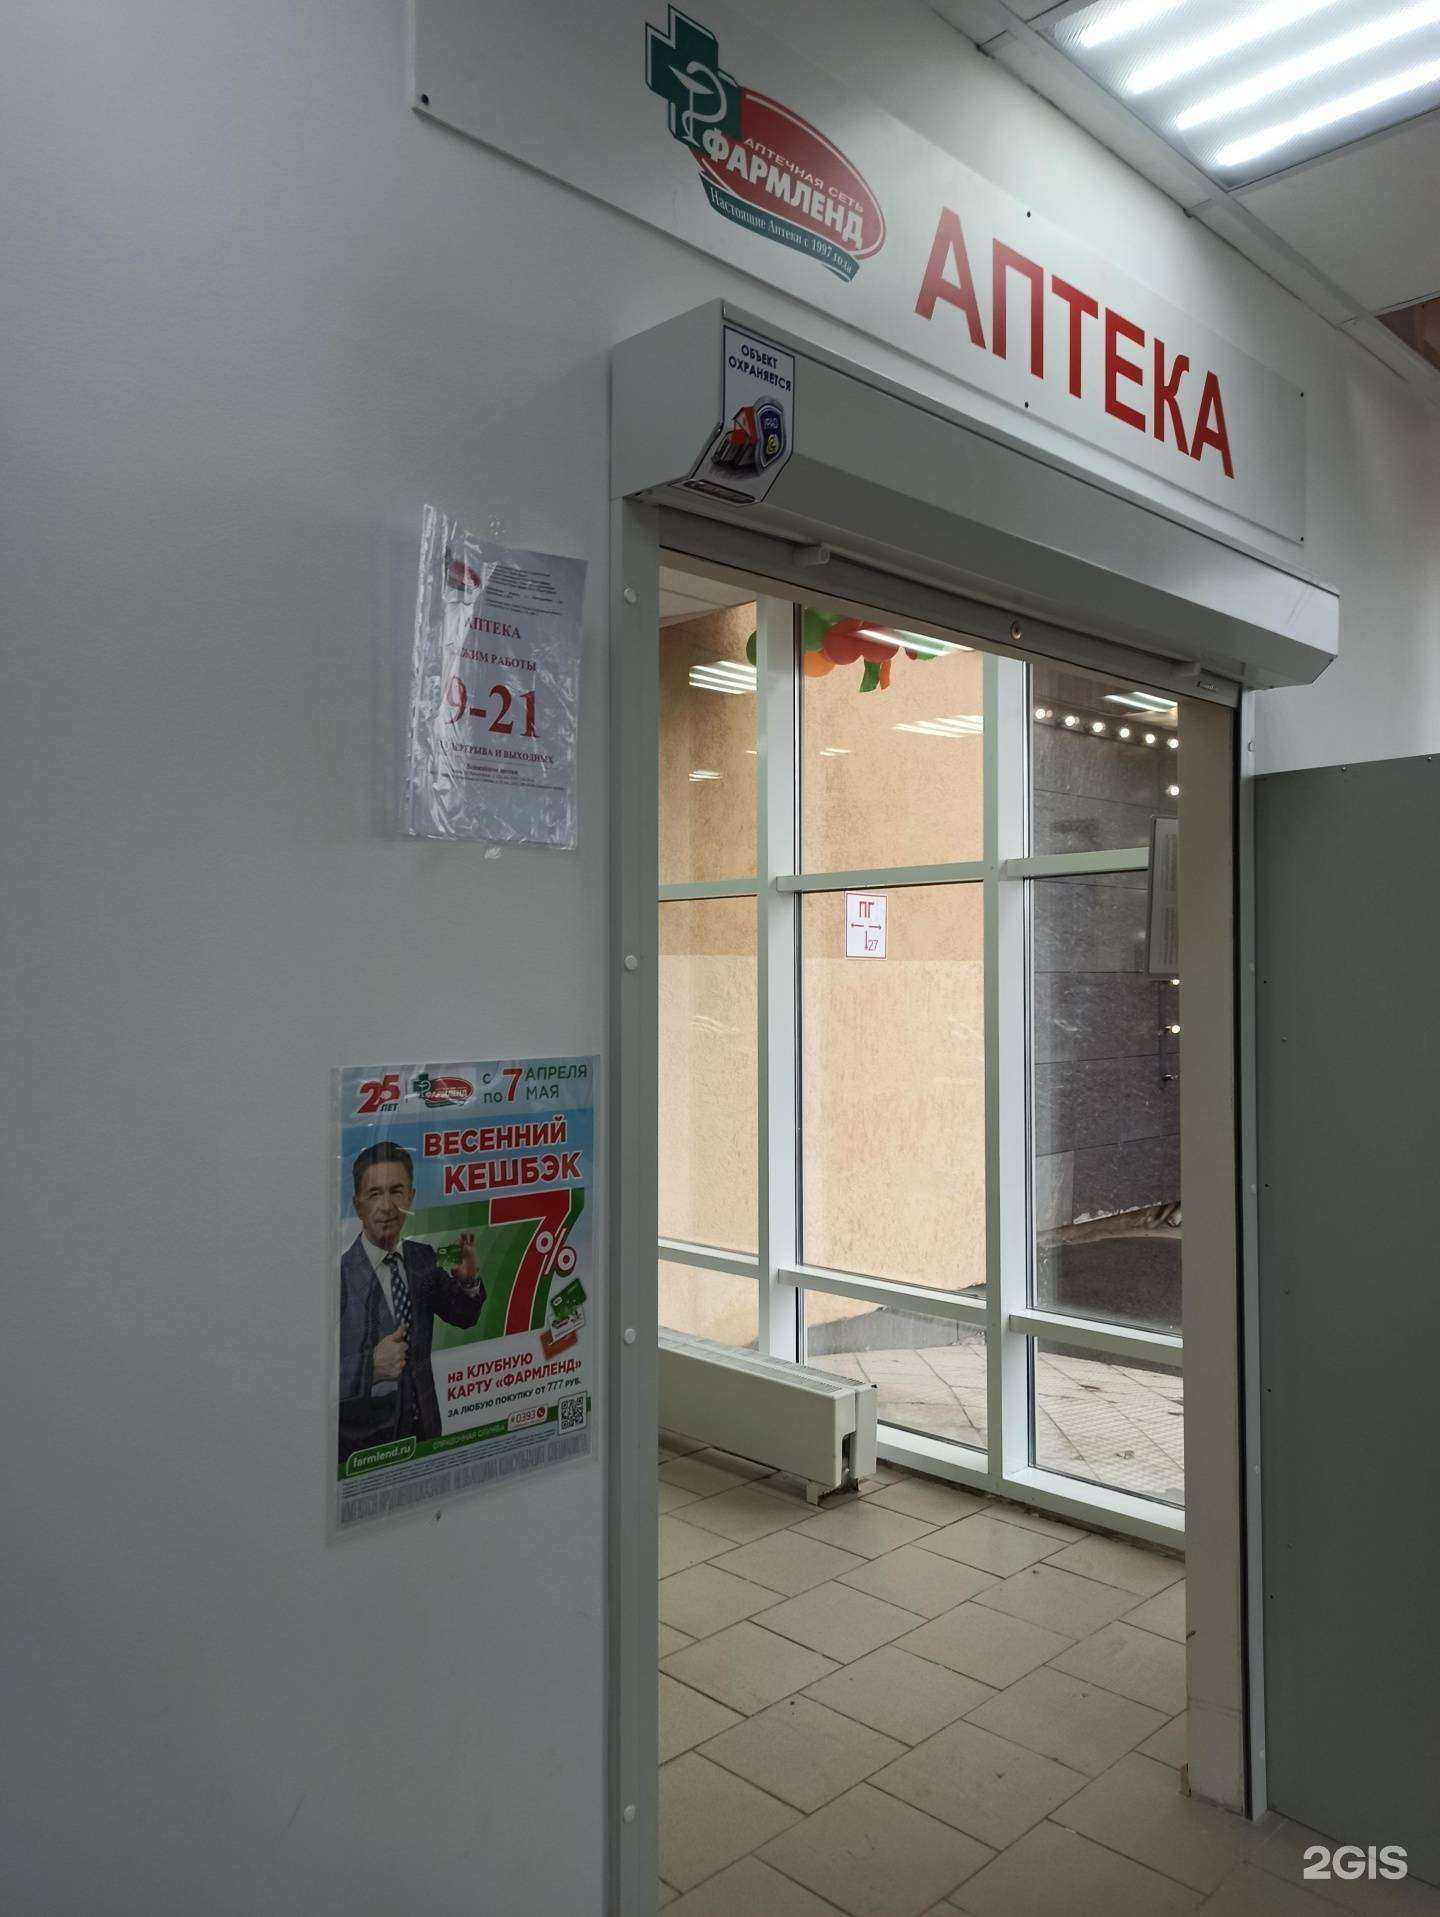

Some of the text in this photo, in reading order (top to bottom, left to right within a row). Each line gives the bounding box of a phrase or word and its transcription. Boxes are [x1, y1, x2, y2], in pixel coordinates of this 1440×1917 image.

[703, 128, 863, 250] ФАРМЛЕНД
[744, 137, 865, 213] АПТЕЧНАЯ СЕТЬ
[710, 187, 767, 230] Настоящие
[811, 239, 833, 258] 1997
[741, 344, 778, 369] ОБЪЕКТ
[915, 206, 1235, 480] АПТЕКА
[728, 356, 792, 392] ОХРАНЯЕТСЯ
[490, 655, 537, 672] РАБОТЫ
[859, 901, 875, 919] ПГ
[868, 939, 879, 952] 27
[503, 1068, 523, 1101] 7
[526, 1064, 587, 1081] АПРЕЛЯ
[526, 1084, 560, 1100] МАЯ
[423, 1115, 567, 1158] ВЕСЕННИЙ
[443, 1151, 582, 1195] КЕШБЭК
[447, 1352, 533, 1384] на КЛУБНУЮ
[447, 1359, 582, 1401] КАРТУ «ФАРМЛЕНД»
[447, 1409, 459, 1418] ЗА
[460, 1400, 494, 1417] ЛЮБУЮ
[495, 1389, 534, 1405] ПОКУПКУ
[535, 1386, 545, 1395] ОТ
[547, 1380, 564, 1392] 777
